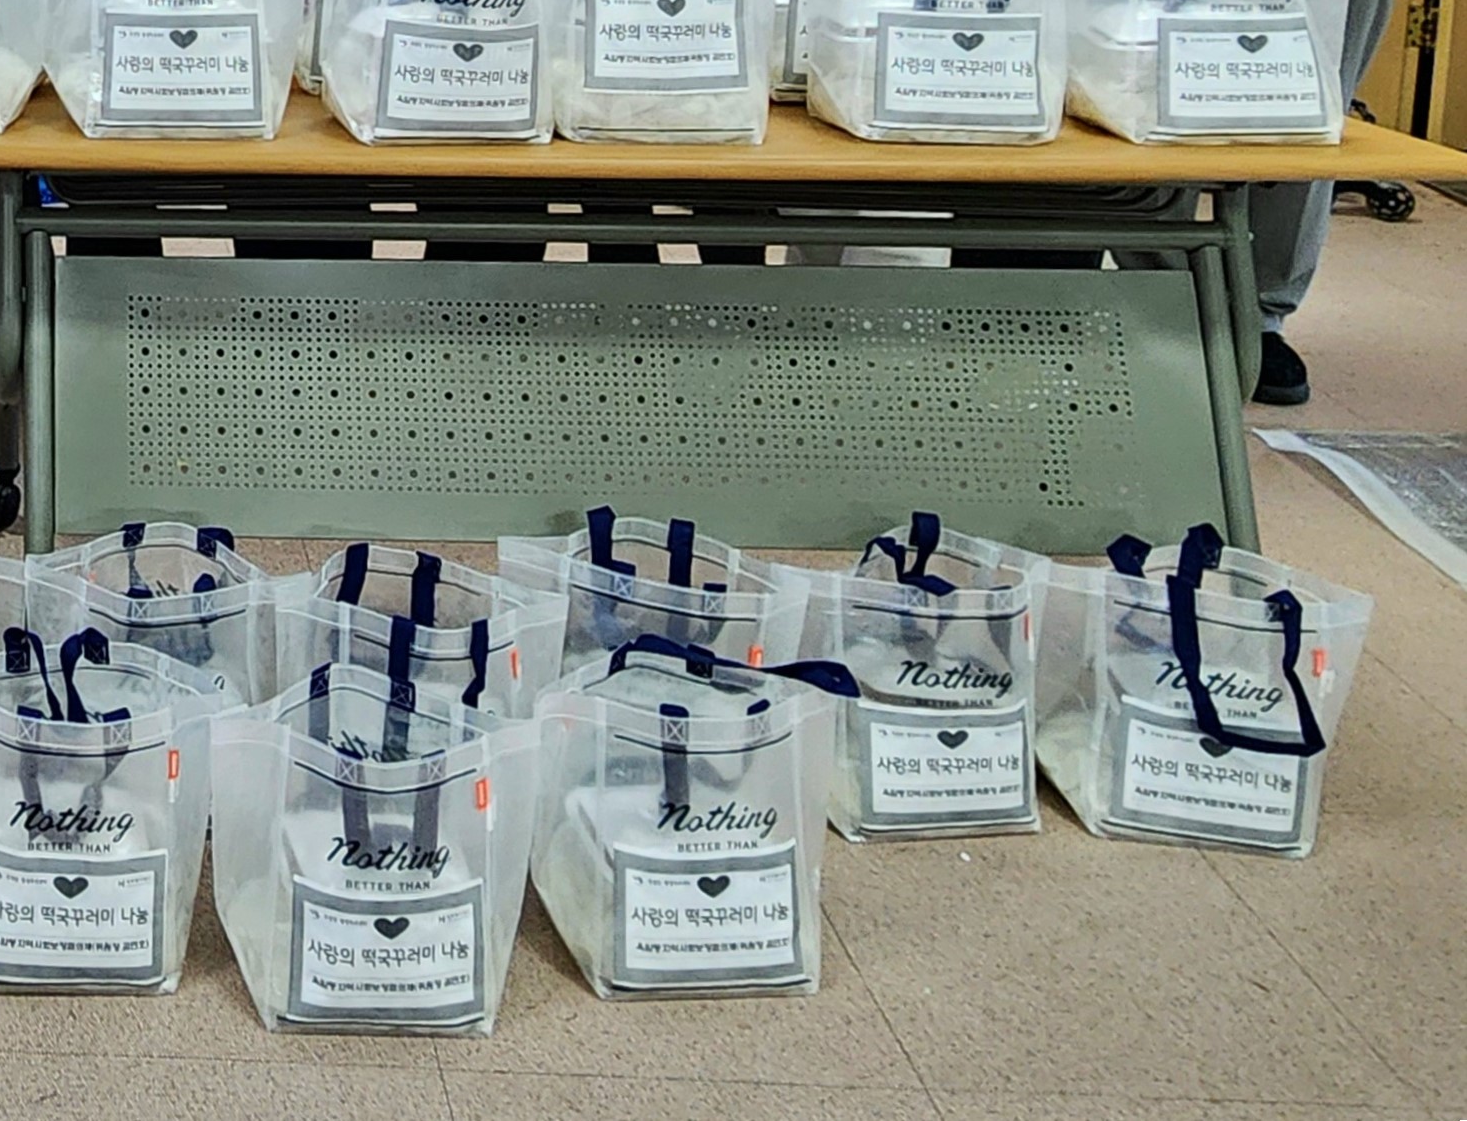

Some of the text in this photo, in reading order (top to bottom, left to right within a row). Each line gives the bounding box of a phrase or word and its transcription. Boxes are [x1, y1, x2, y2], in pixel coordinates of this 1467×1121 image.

[599, 24, 641, 41] 사랑의
[116, 55, 154, 73] 사랑의
[891, 57, 935, 75] 사랑의
[1175, 62, 1220, 79] 사랑의
[395, 66, 434, 83] 사랑의
[897, 661, 1013, 699] Nothing
[1156, 661, 1283, 712] Nthing
[877, 757, 921, 775] 사랑의
[1132, 753, 1178, 777] 사랑의
[10, 801, 135, 843] Nothing
[657, 801, 778, 839] Nothing
[27, 842, 111, 853] BETTER THAN
[677, 841, 758, 853] BETTER THAN
[327, 836, 452, 879] Nothing
[345, 879, 430, 891] BETTER THAN
[631, 907, 679, 928] 사랑의
[308, 938, 355, 967] 사랑의
